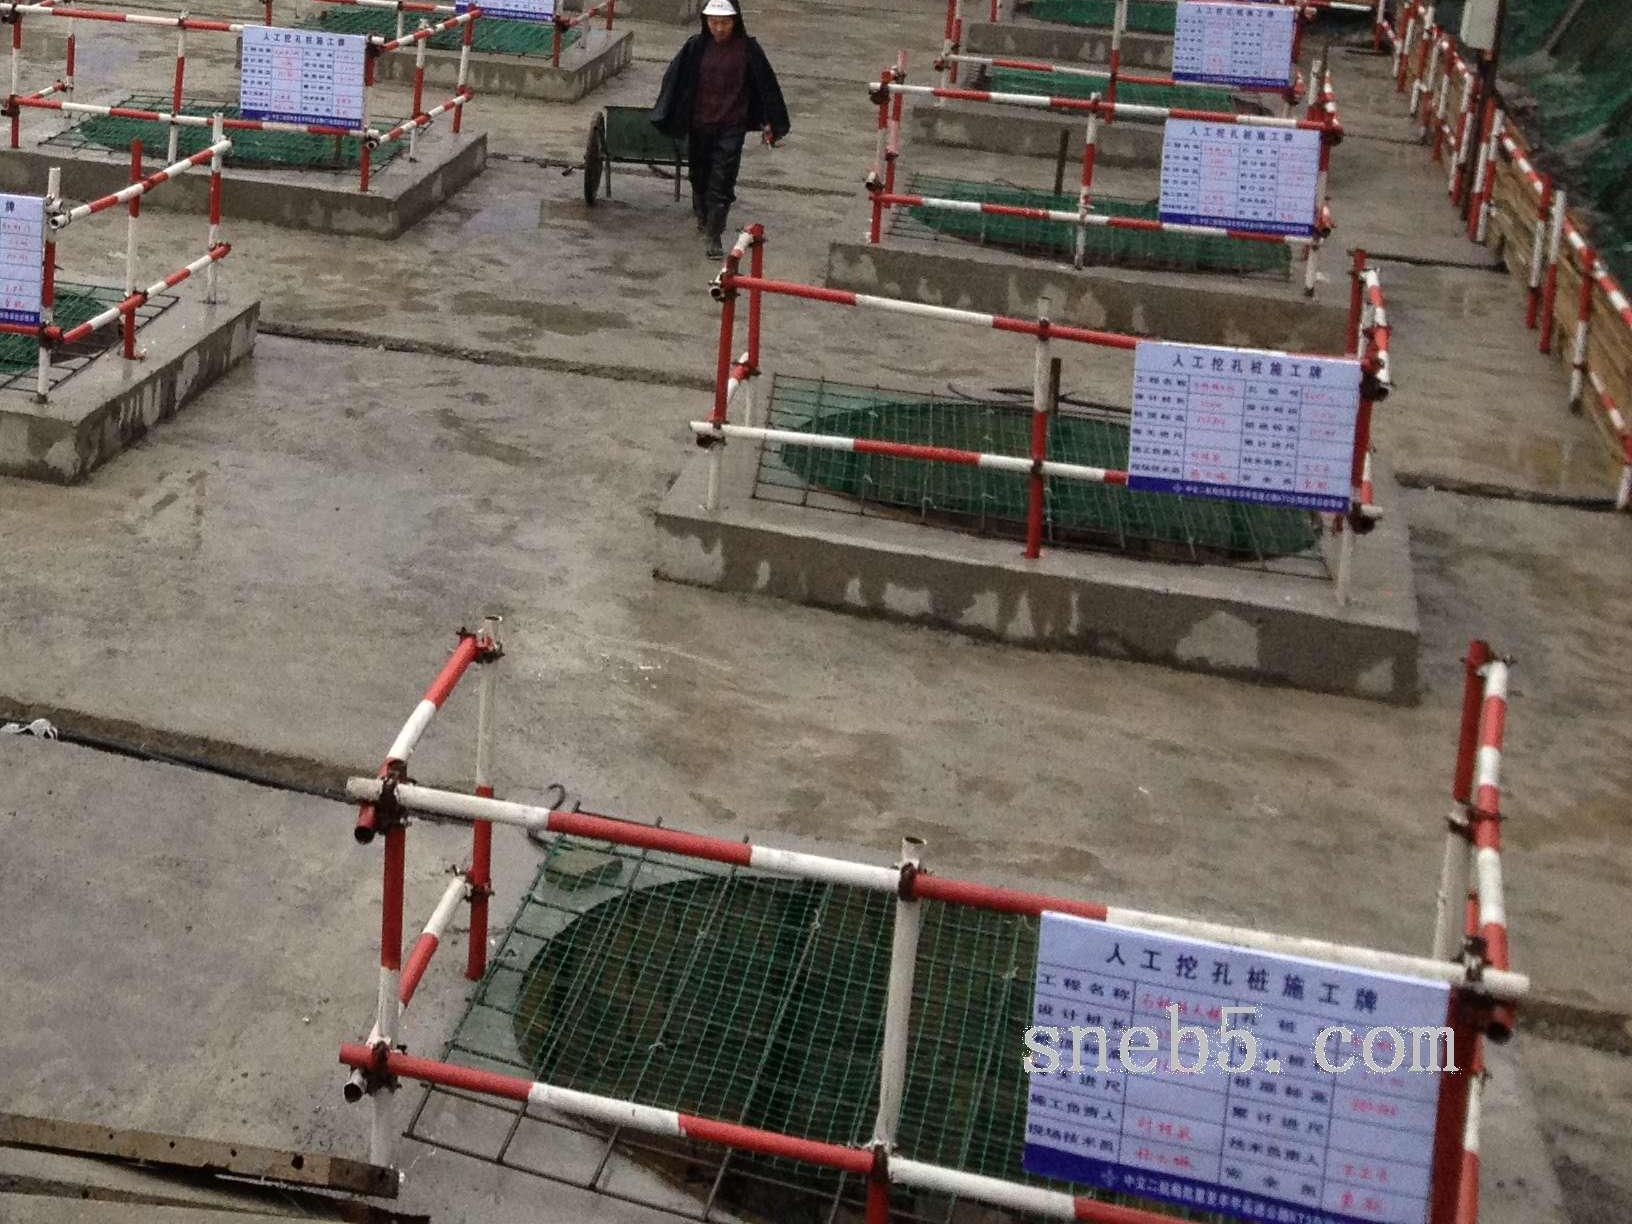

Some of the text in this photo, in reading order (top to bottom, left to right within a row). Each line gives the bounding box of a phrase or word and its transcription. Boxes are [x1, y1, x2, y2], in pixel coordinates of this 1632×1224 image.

[1172, 353, 1323, 380] 人工挖孔桩施工牌
[1039, 972, 1130, 1003] 工程名称
[1106, 942, 1379, 1012] 人工挖孔桩施工牌
